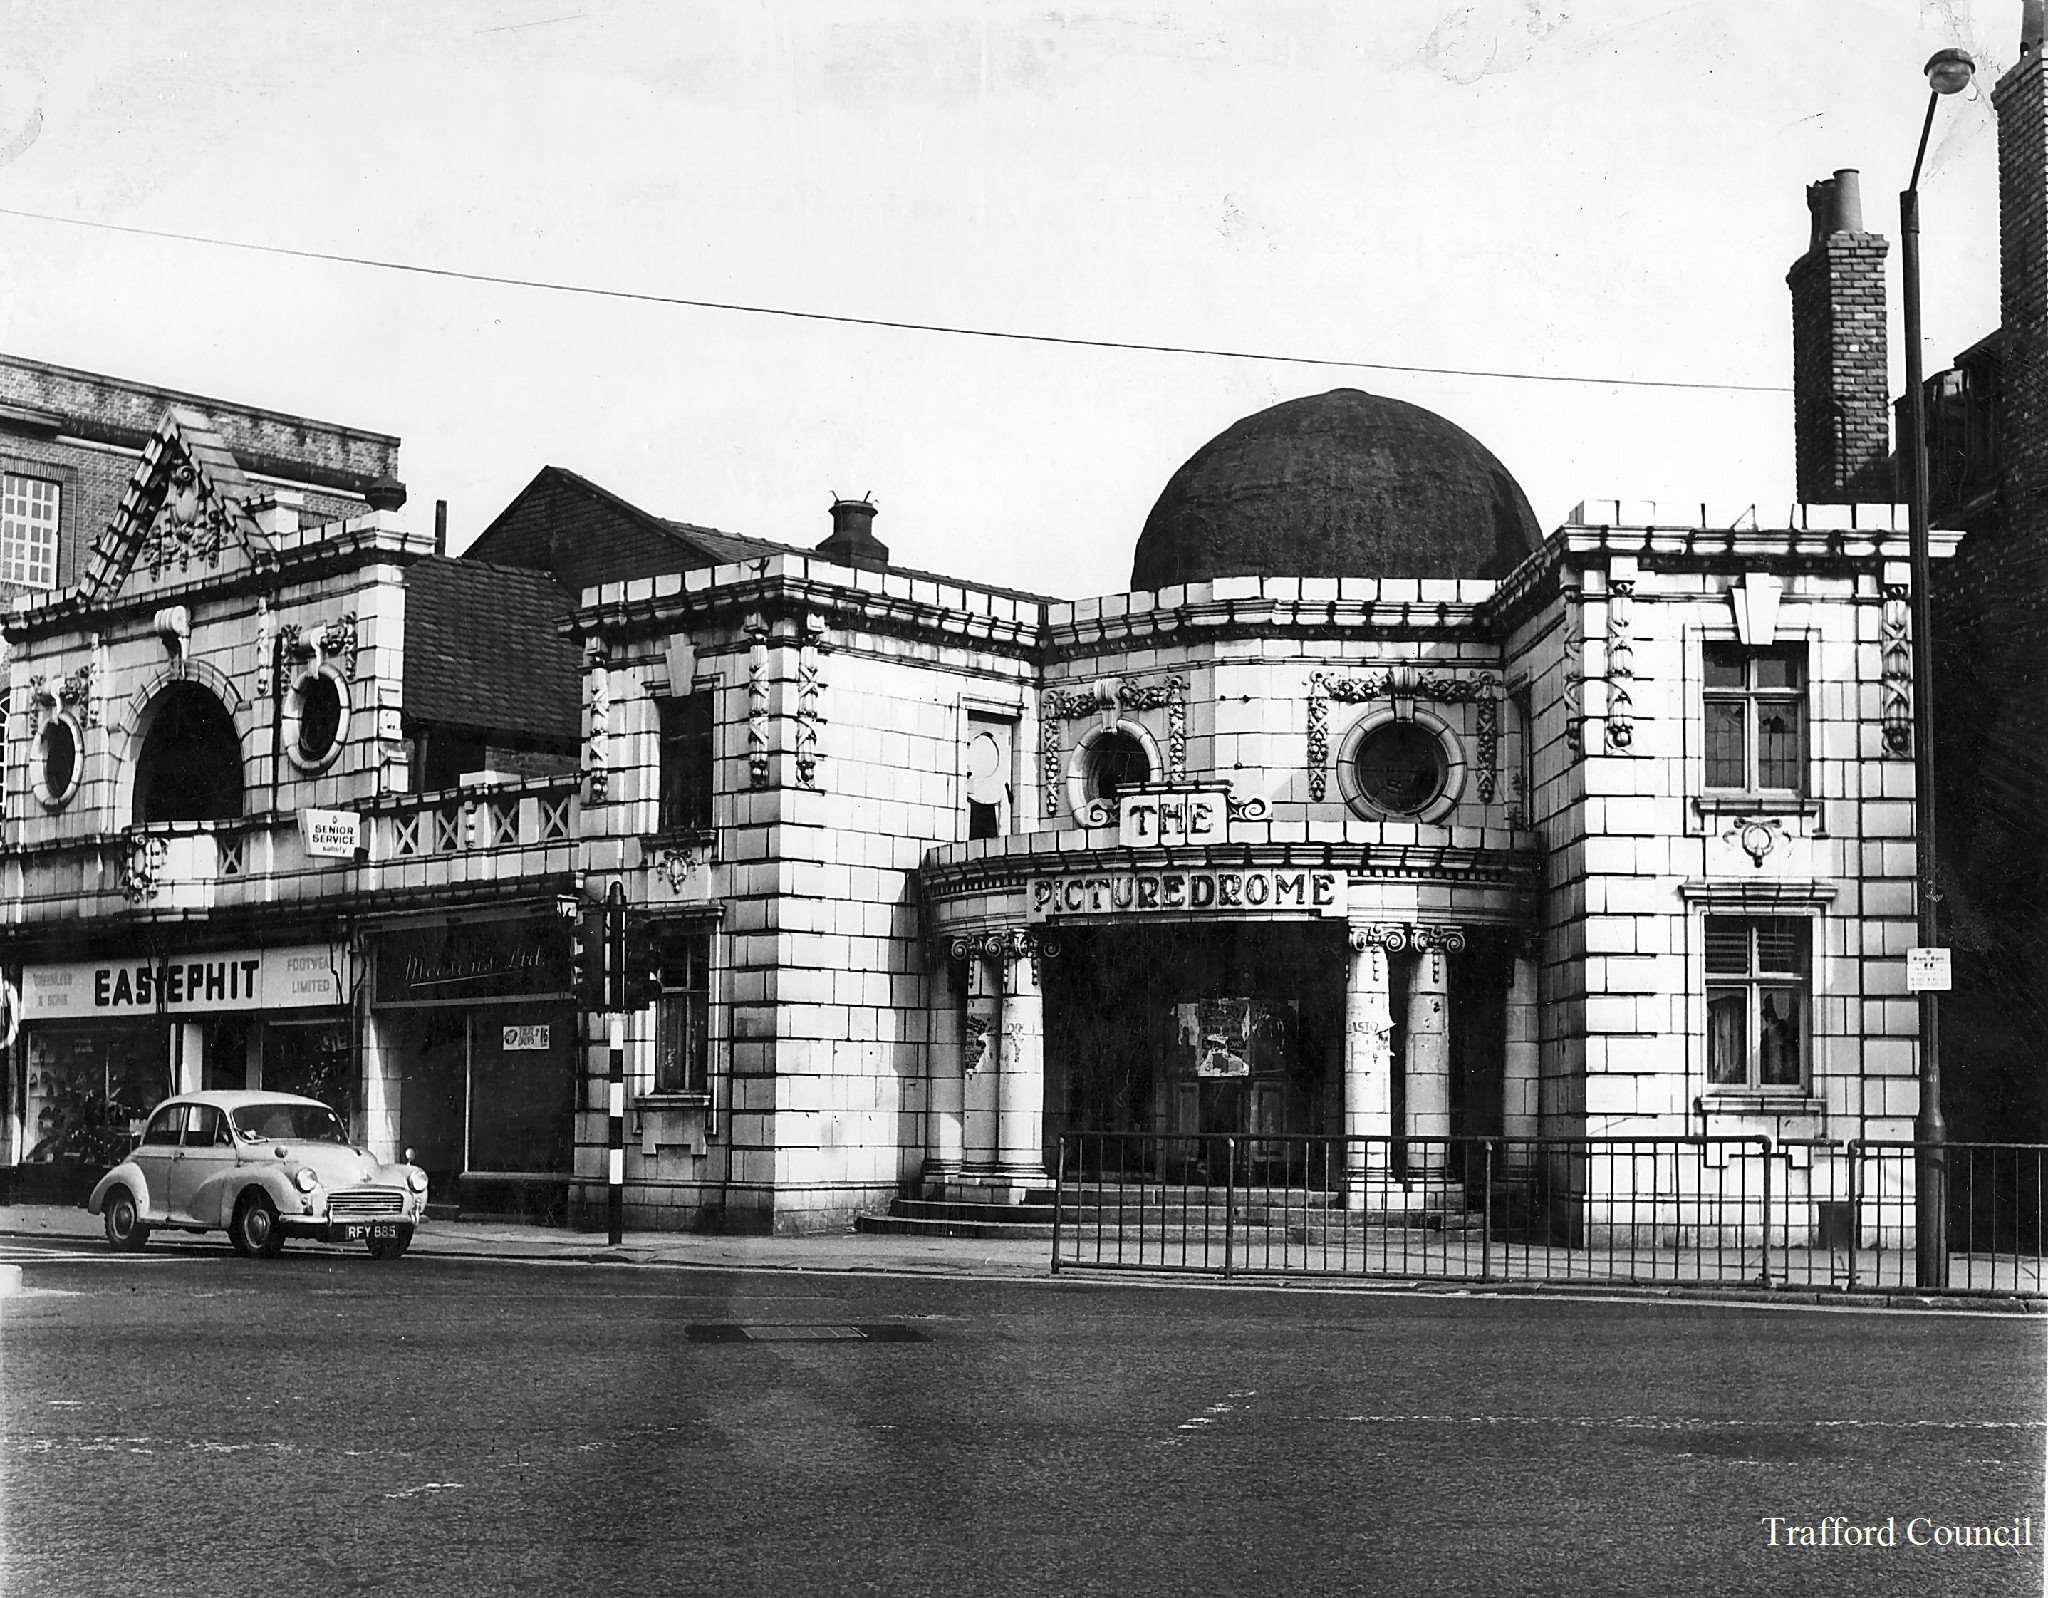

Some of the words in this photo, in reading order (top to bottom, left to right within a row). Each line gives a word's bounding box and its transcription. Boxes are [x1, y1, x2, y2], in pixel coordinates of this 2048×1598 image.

[1129, 803, 1212, 836] THE
[315, 824, 354, 835] SENIOR
[312, 833, 355, 845] SERVICE
[1033, 873, 1337, 913] PICTUREDROME
[287, 957, 332, 971] FOOTWEA
[291, 979, 330, 993] LIMITED
[348, 1226, 371, 1239] RFY
[374, 1225, 396, 1238] 885
